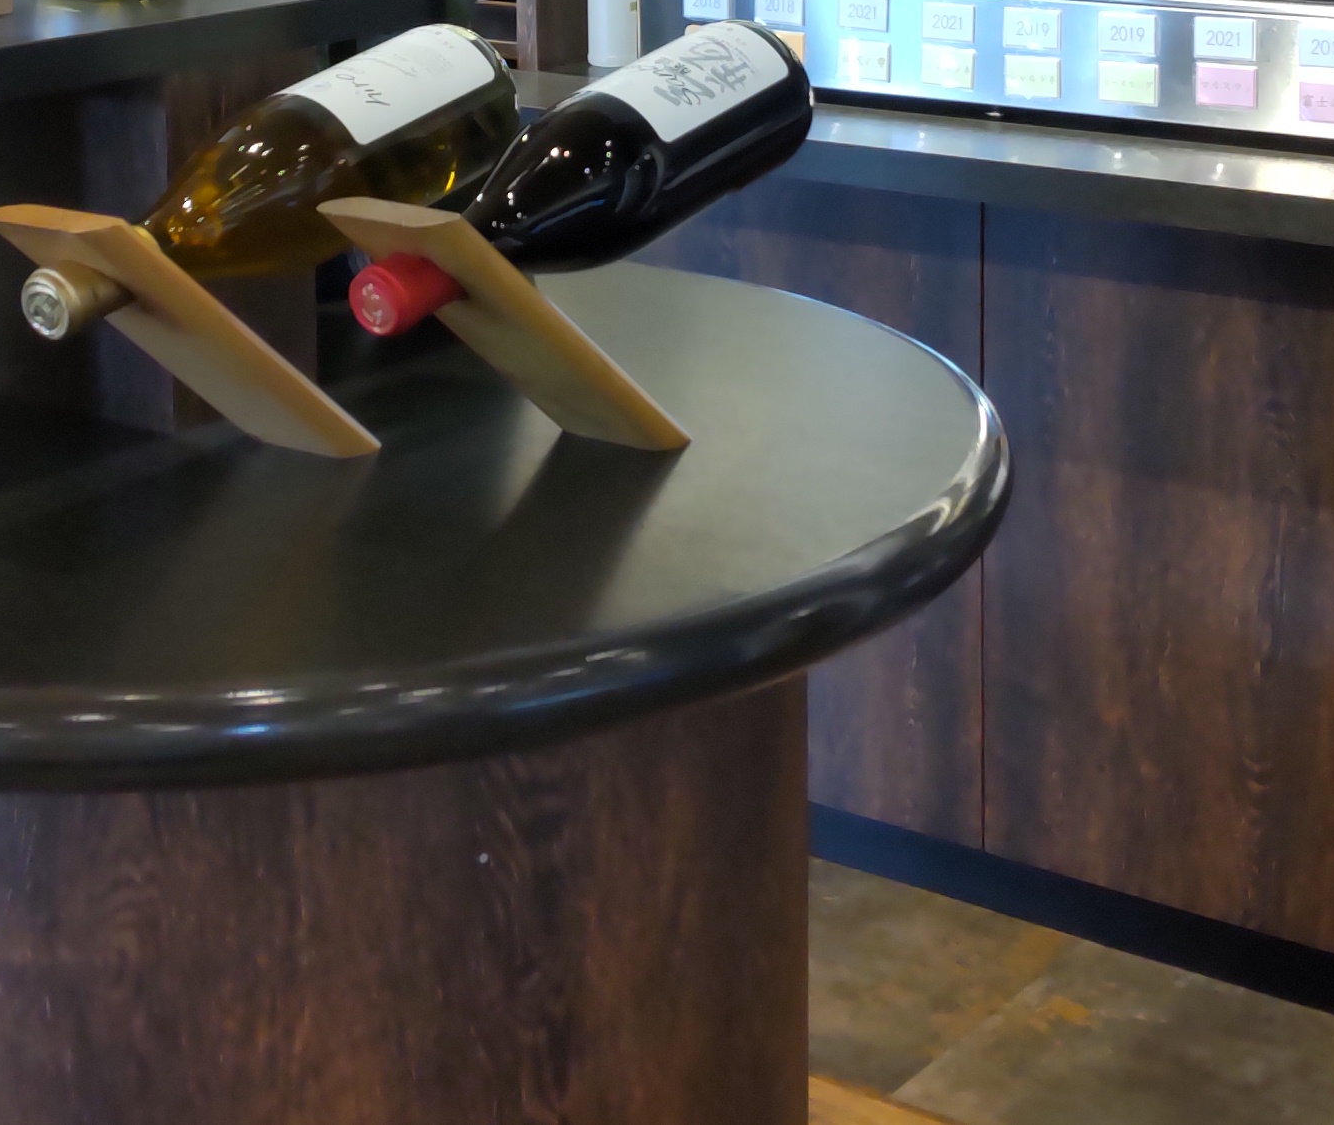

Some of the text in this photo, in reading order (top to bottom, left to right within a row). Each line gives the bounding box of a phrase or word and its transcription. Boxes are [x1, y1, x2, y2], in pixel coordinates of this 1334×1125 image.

[847, 3, 876, 19] 2021
[932, 14, 963, 30] 2021
[1110, 26, 1145, 42] 2019
[1206, 30, 1240, 46] 2021
